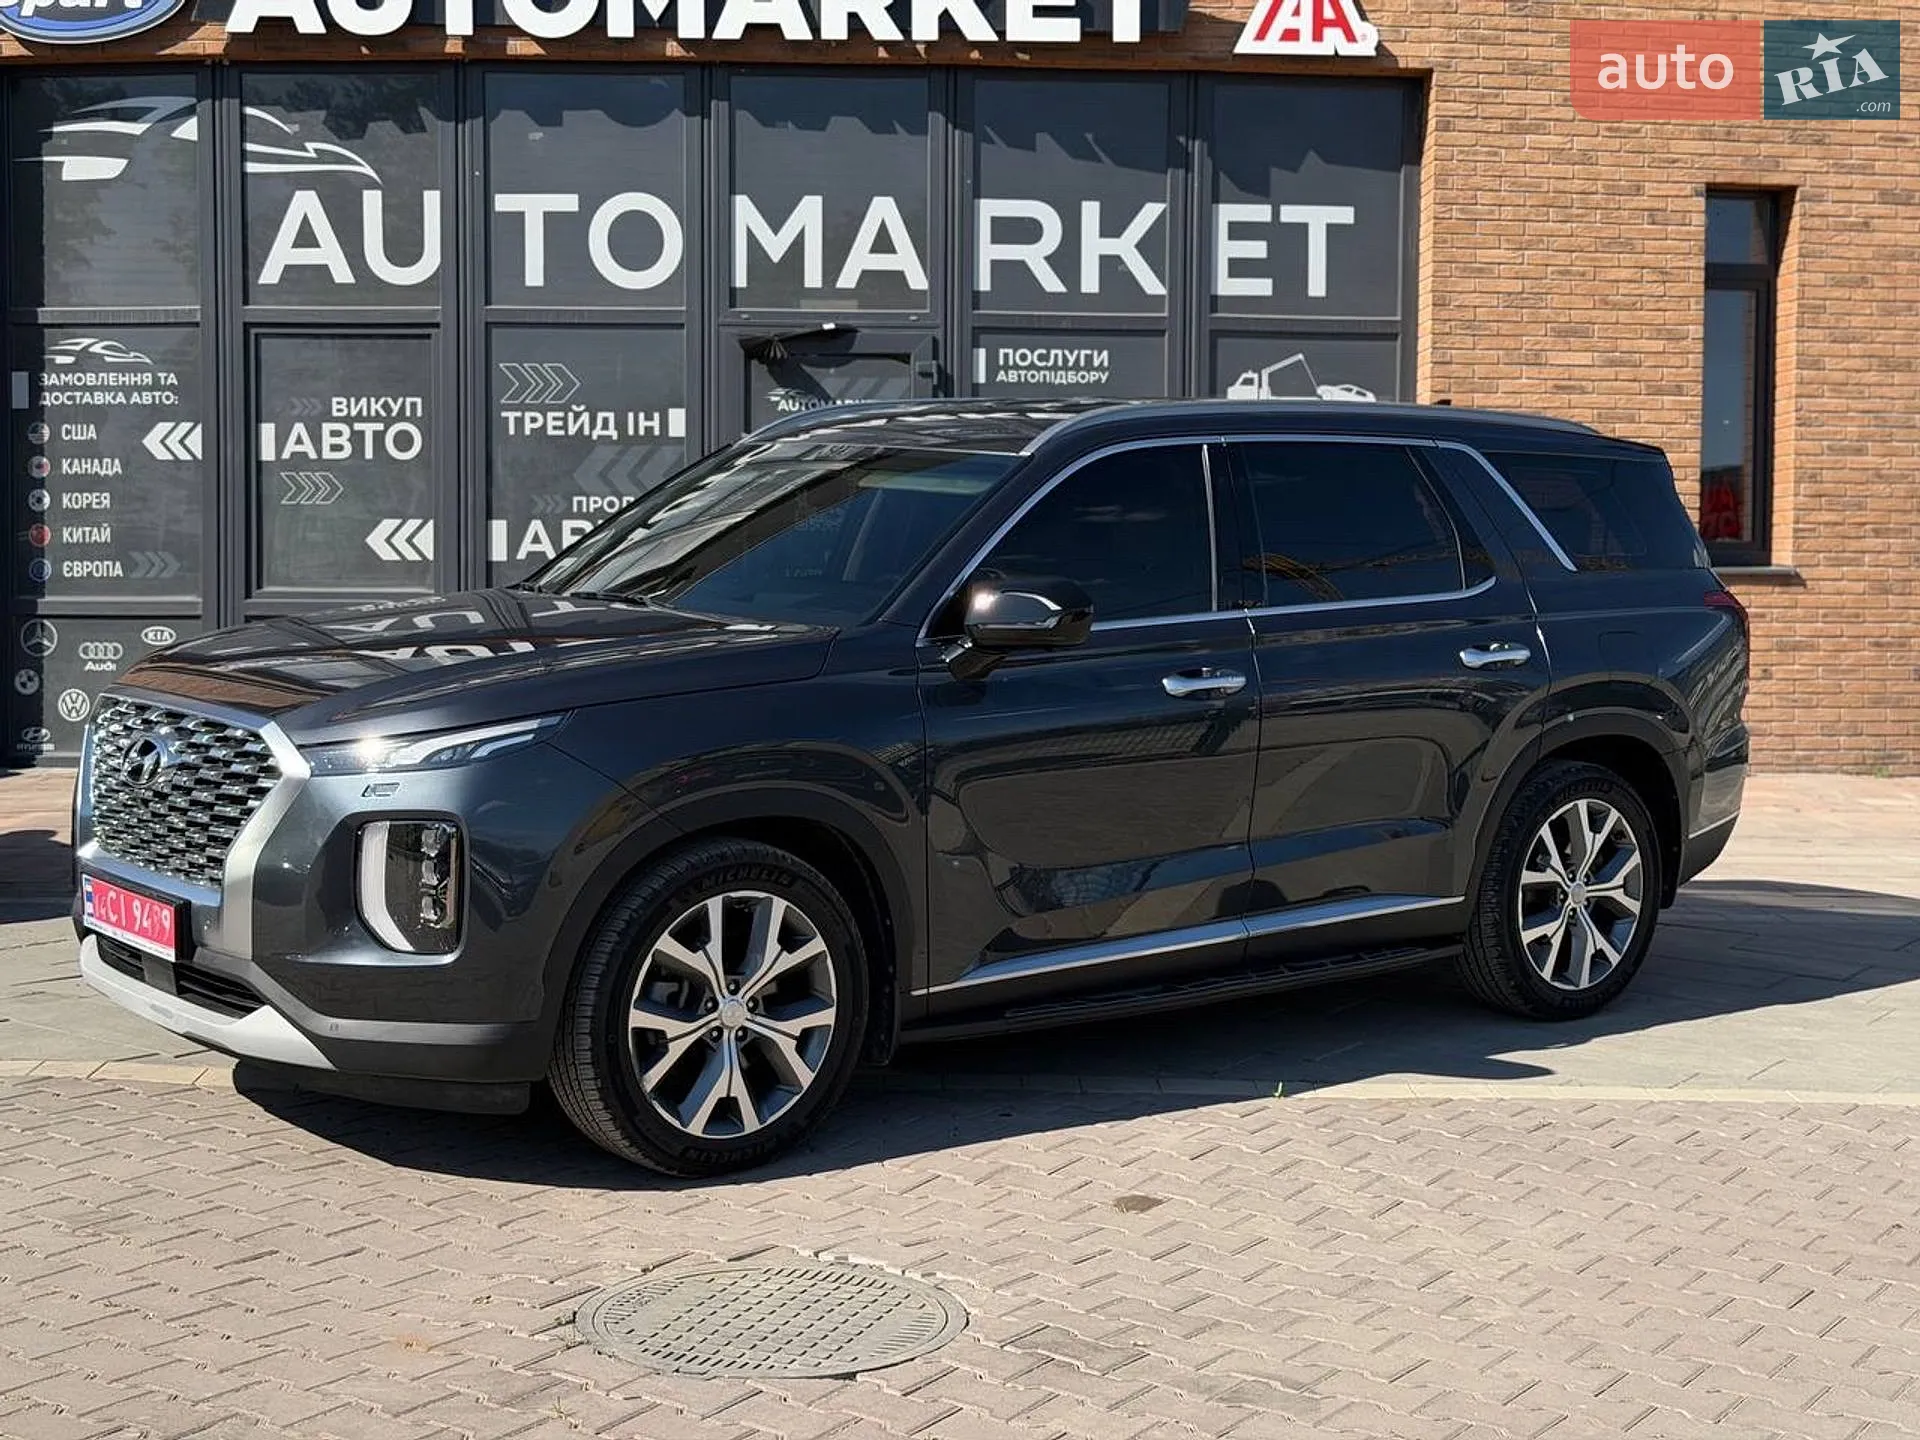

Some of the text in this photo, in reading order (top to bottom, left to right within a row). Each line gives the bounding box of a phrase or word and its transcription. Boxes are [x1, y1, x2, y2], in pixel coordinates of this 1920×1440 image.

[224, 0, 1142, 41] AUOMARKE
[998, 347, 1109, 368] ПОСЛУГИ
[40, 372, 179, 386] ЗАМОВЛЕННЯ ТА
[996, 369, 1109, 385] АВТОПІДБОРУ
[39, 391, 179, 406] ДОСТАВКА АВТО:
[331, 396, 423, 418] ВИКУП
[500, 404, 660, 440] ТРЕЙД ІН
[61, 423, 97, 441] США
[280, 421, 423, 461] АВТО
[61, 458, 122, 476] КАНАДА
[62, 492, 111, 510] КОРЕЯ
[62, 523, 111, 544] КИТАЙ
[516, 519, 604, 561] АВ
[62, 560, 124, 578] ЄВРОПА
[84, 661, 116, 671] Audi
